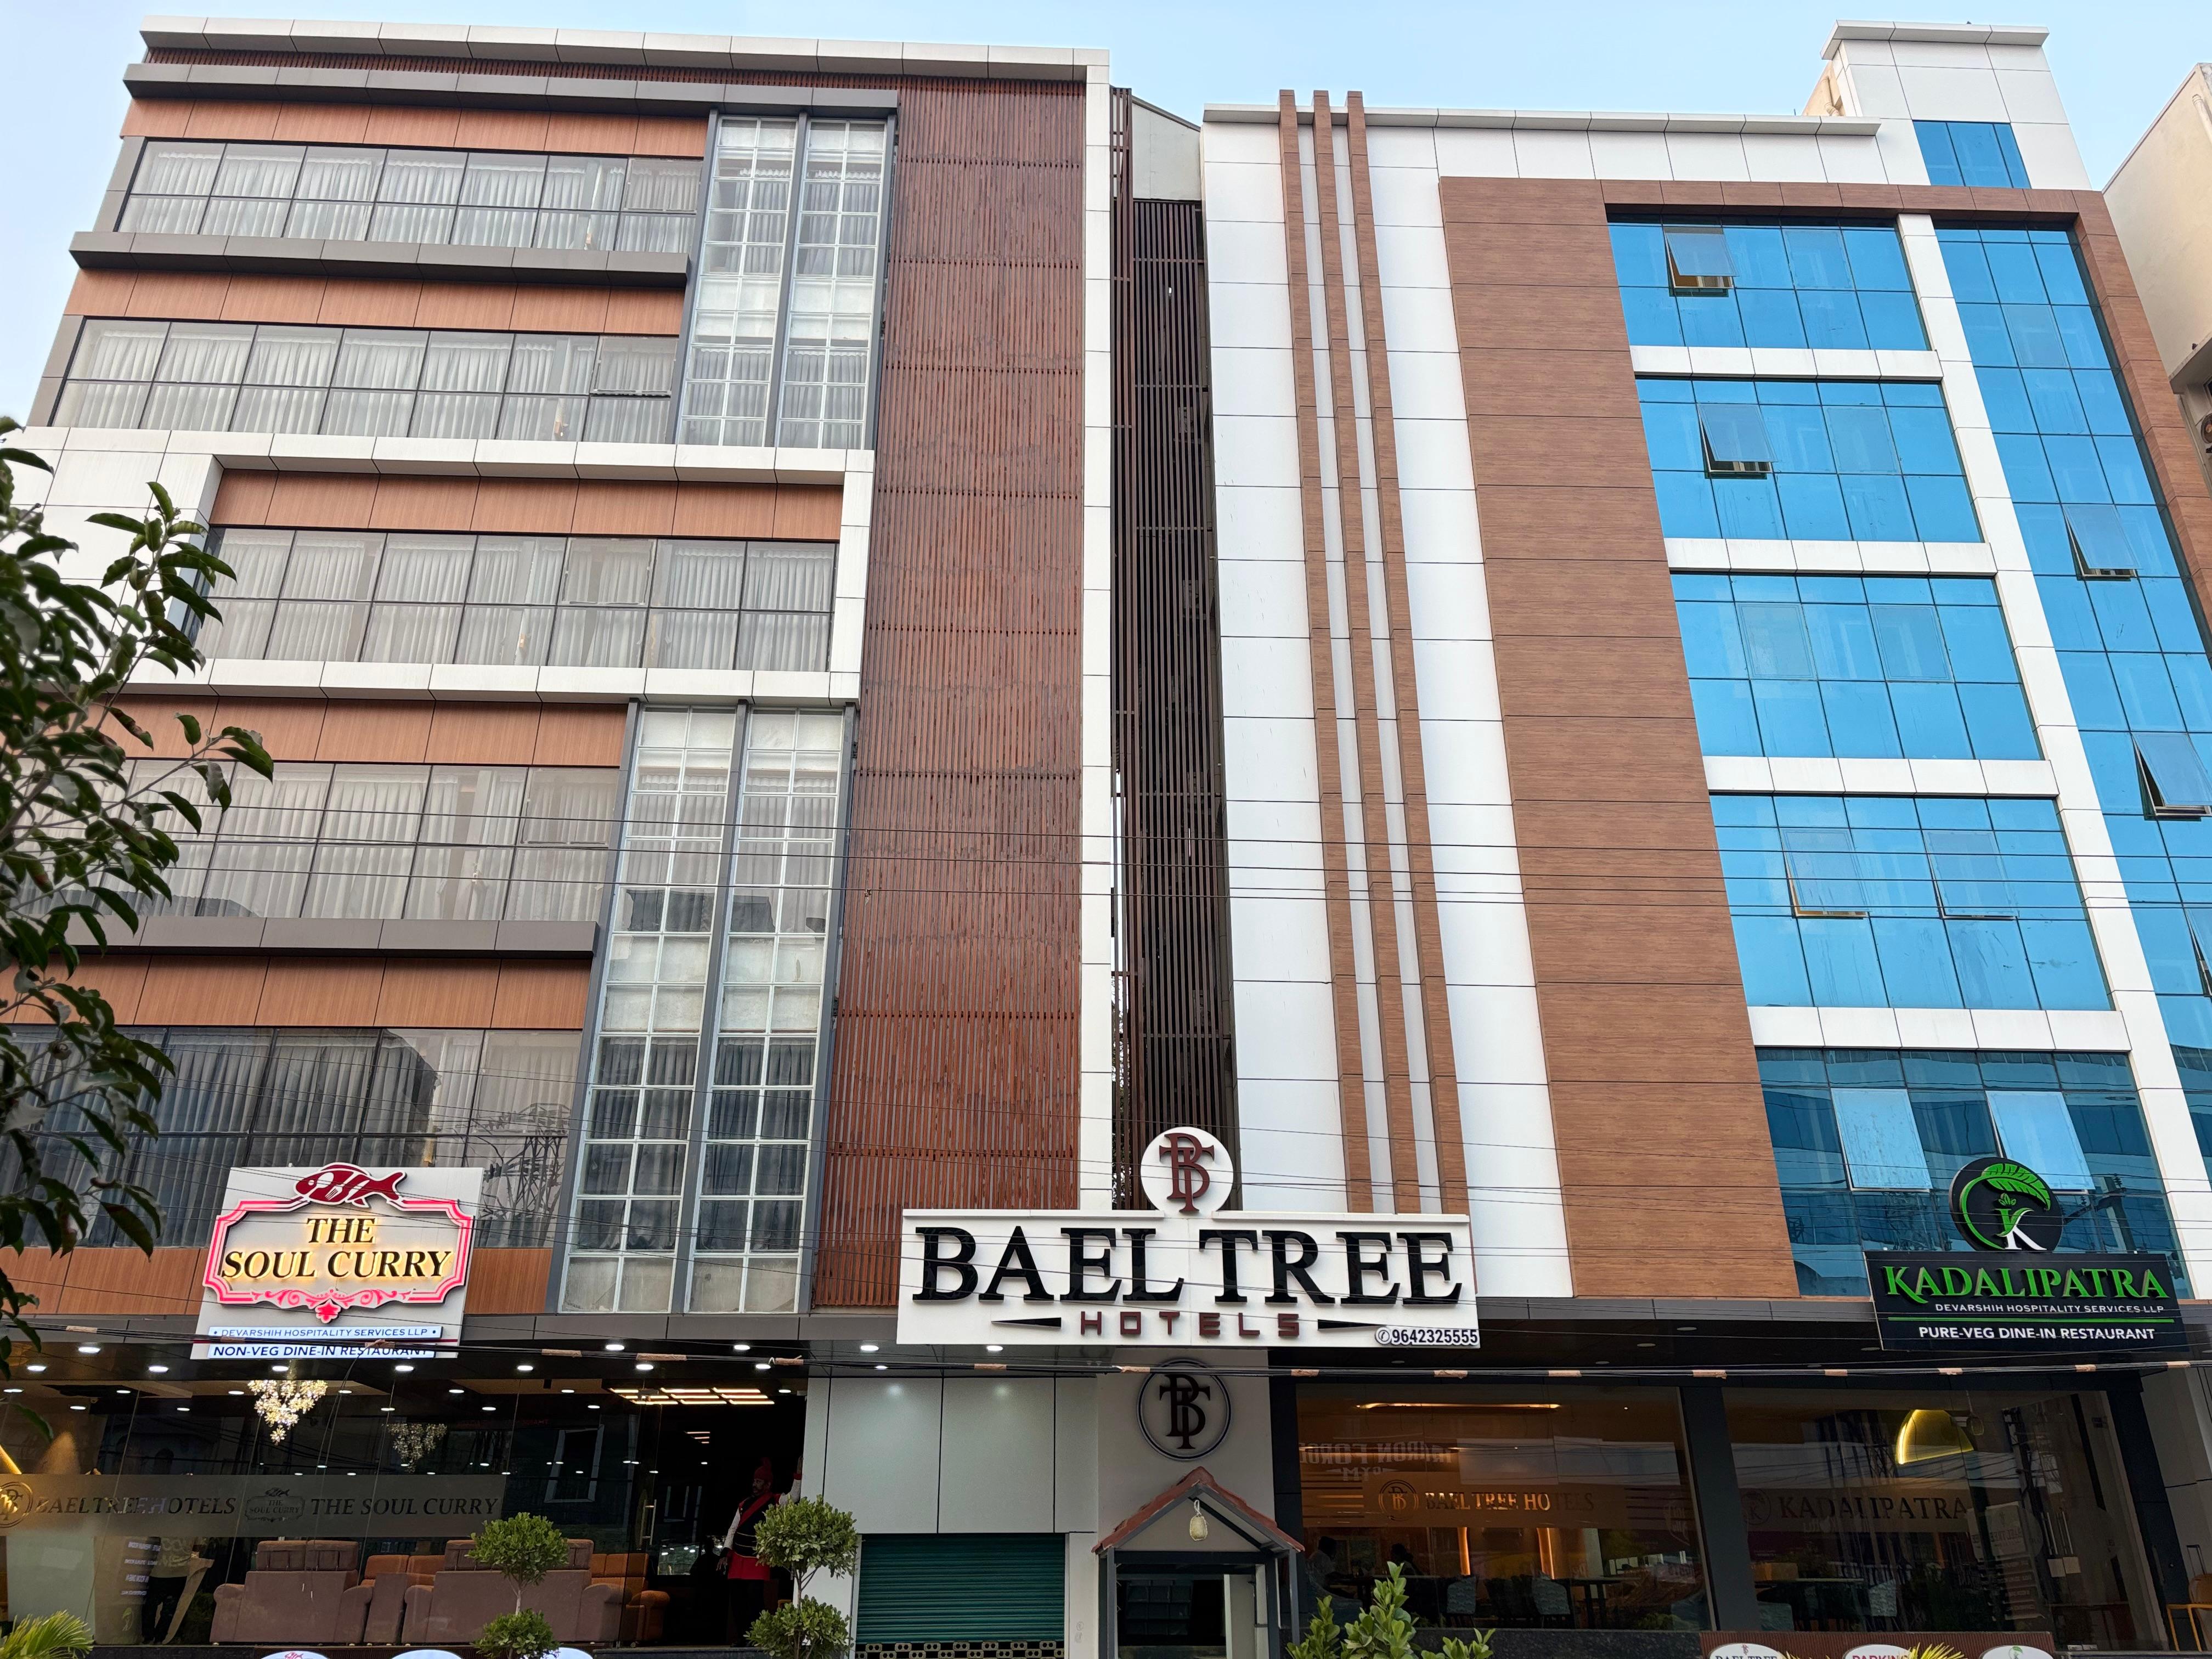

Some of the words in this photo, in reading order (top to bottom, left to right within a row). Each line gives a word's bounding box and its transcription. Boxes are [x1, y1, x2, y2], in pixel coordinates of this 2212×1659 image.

[307, 1218, 375, 1244] THE
[221, 1251, 317, 1278] SOUL
[328, 1251, 452, 1278] CURRY
[912, 1226, 1184, 1302] BAEL
[1199, 1229, 1463, 1306] TREE
[1882, 1266, 2170, 1305] KADALIPATRA
[1936, 1304, 2004, 1312] DEVARSHIH
[2007, 1305, 2081, 1313] HOSPITALITY
[2084, 1305, 2141, 1313] SERVICES
[1081, 1311, 1300, 1337] HOTELS
[221, 1329, 283, 1337] DEVARSHIH
[1391, 1329, 1478, 1344] 9642325555
[1918, 1327, 1995, 1339] PURE-VEG
[1999, 1327, 2056, 1339] DINE-IN
[2060, 1328, 2155, 1340] RESTAURANT
[213, 1346, 279, 1356] NON-VEG
[284, 1346, 336, 1356] DINE-IN
[311, 1498, 356, 1515] THE
[360, 1498, 418, 1515] SOUL
[424, 1498, 499, 1515] CURRY
